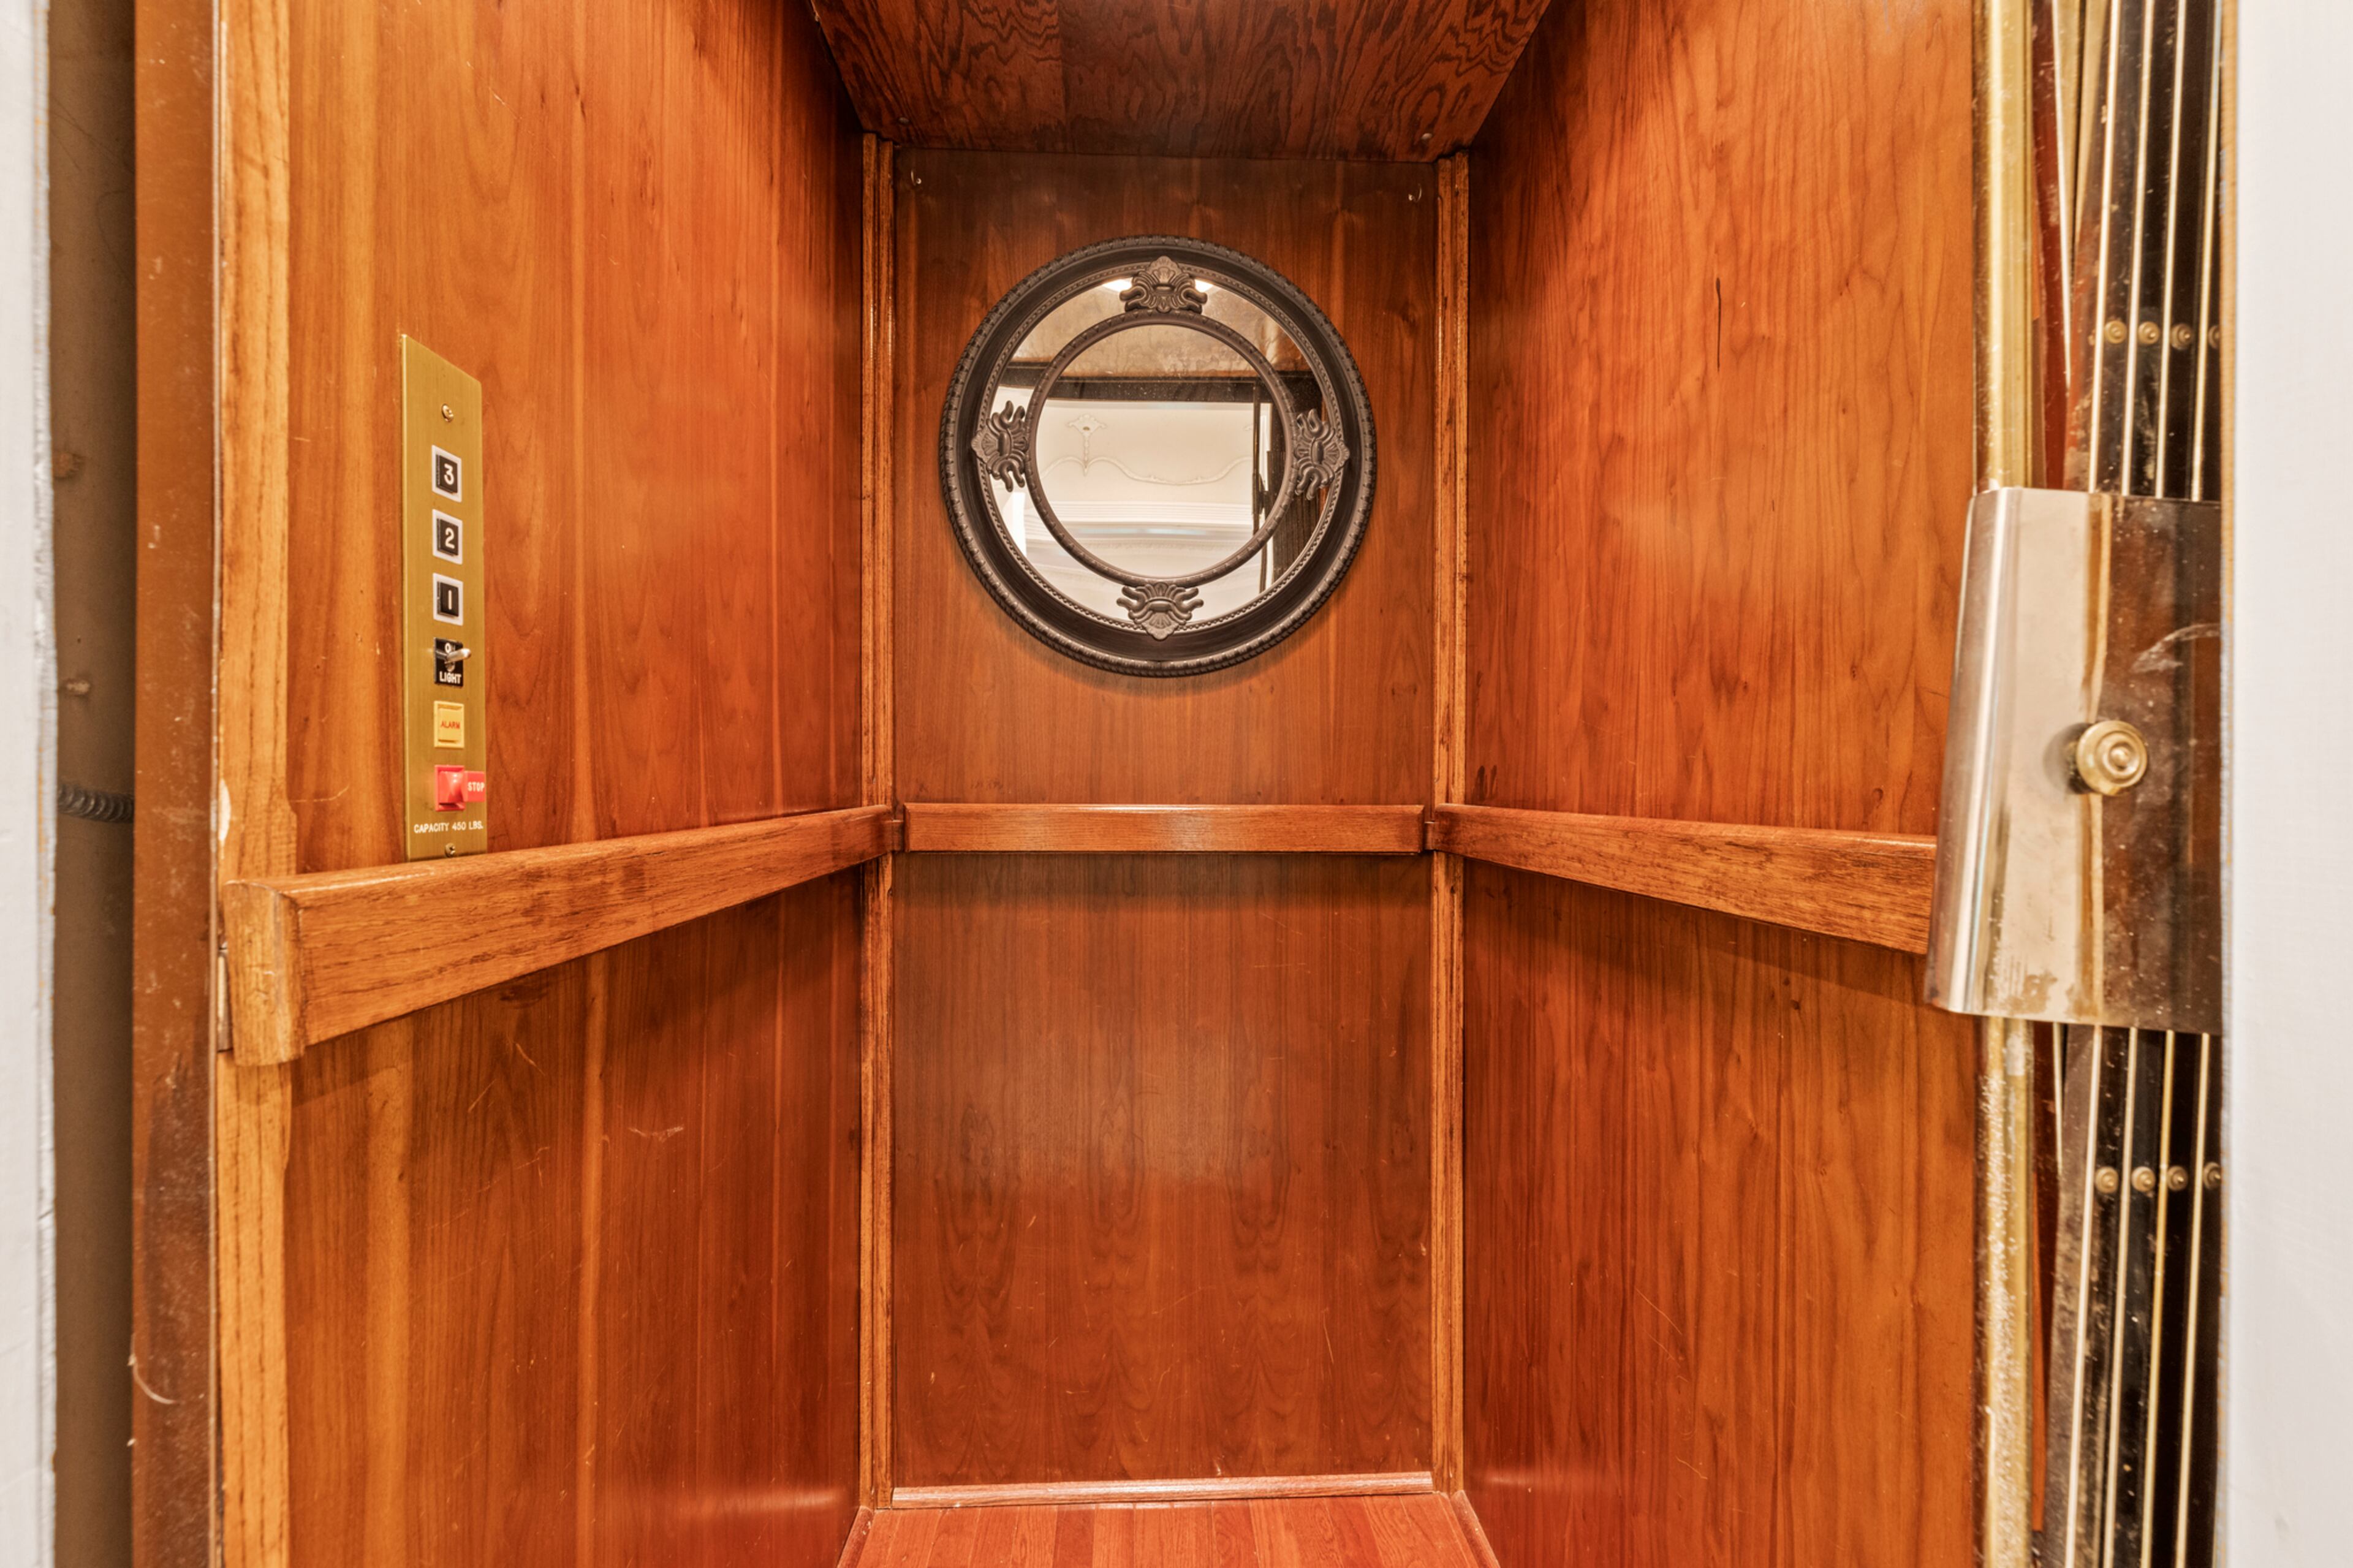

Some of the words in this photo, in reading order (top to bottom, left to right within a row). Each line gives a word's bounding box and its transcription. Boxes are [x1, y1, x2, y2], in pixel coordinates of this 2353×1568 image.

[444, 463, 454, 485] 3
[445, 528, 455, 549] 2
[448, 589, 452, 610] 1
[439, 671, 461, 684] LIGHT
[441, 721, 460, 729] ALARM
[468, 782, 485, 792] STOP
[414, 822, 449, 833] CAPACITY
[452, 821, 466, 831] 450
[469, 820, 483, 830] LBS.
